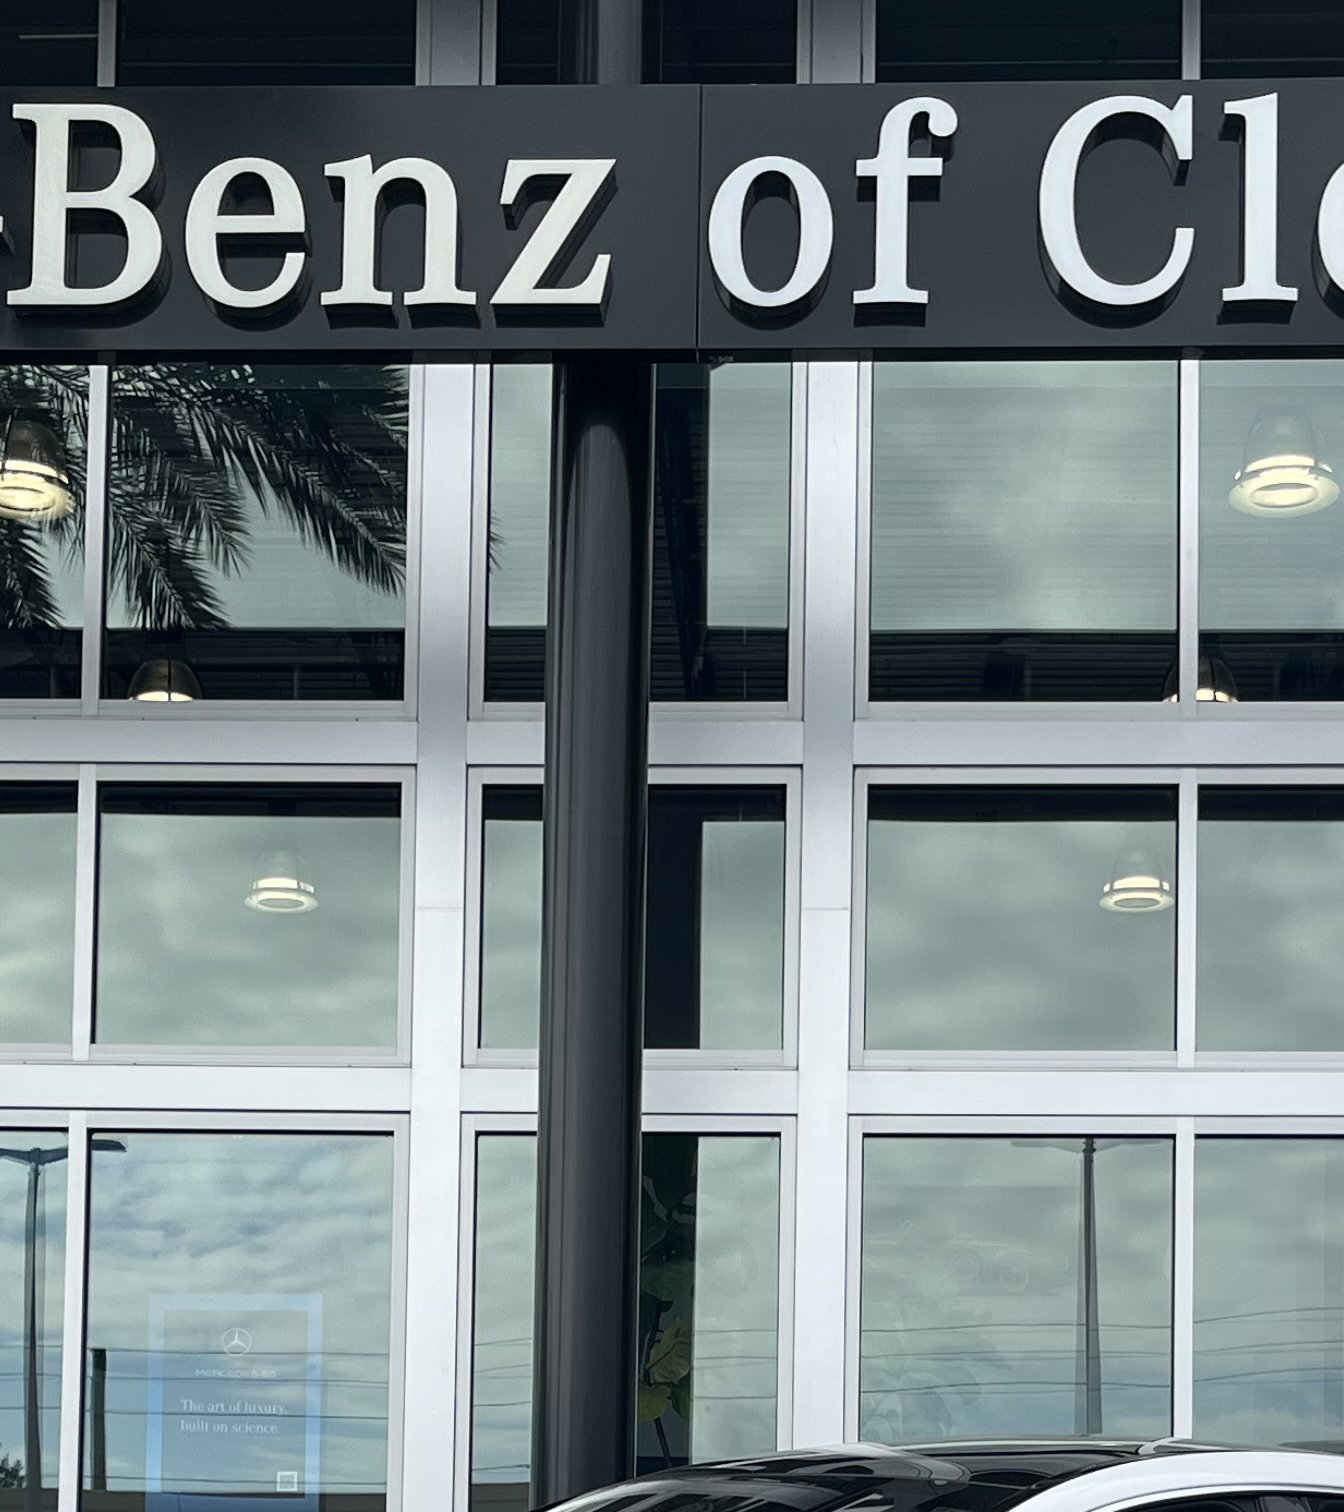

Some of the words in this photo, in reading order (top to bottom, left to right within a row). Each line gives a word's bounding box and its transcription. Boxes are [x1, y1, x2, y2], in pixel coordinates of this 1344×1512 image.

[708, 95, 958, 308] of
[180, 1398, 205, 1412] The
[207, 1401, 224, 1413] art
[228, 1400, 242, 1413] of
[180, 1418, 209, 1433] built
[212, 1423, 228, 1433] on
